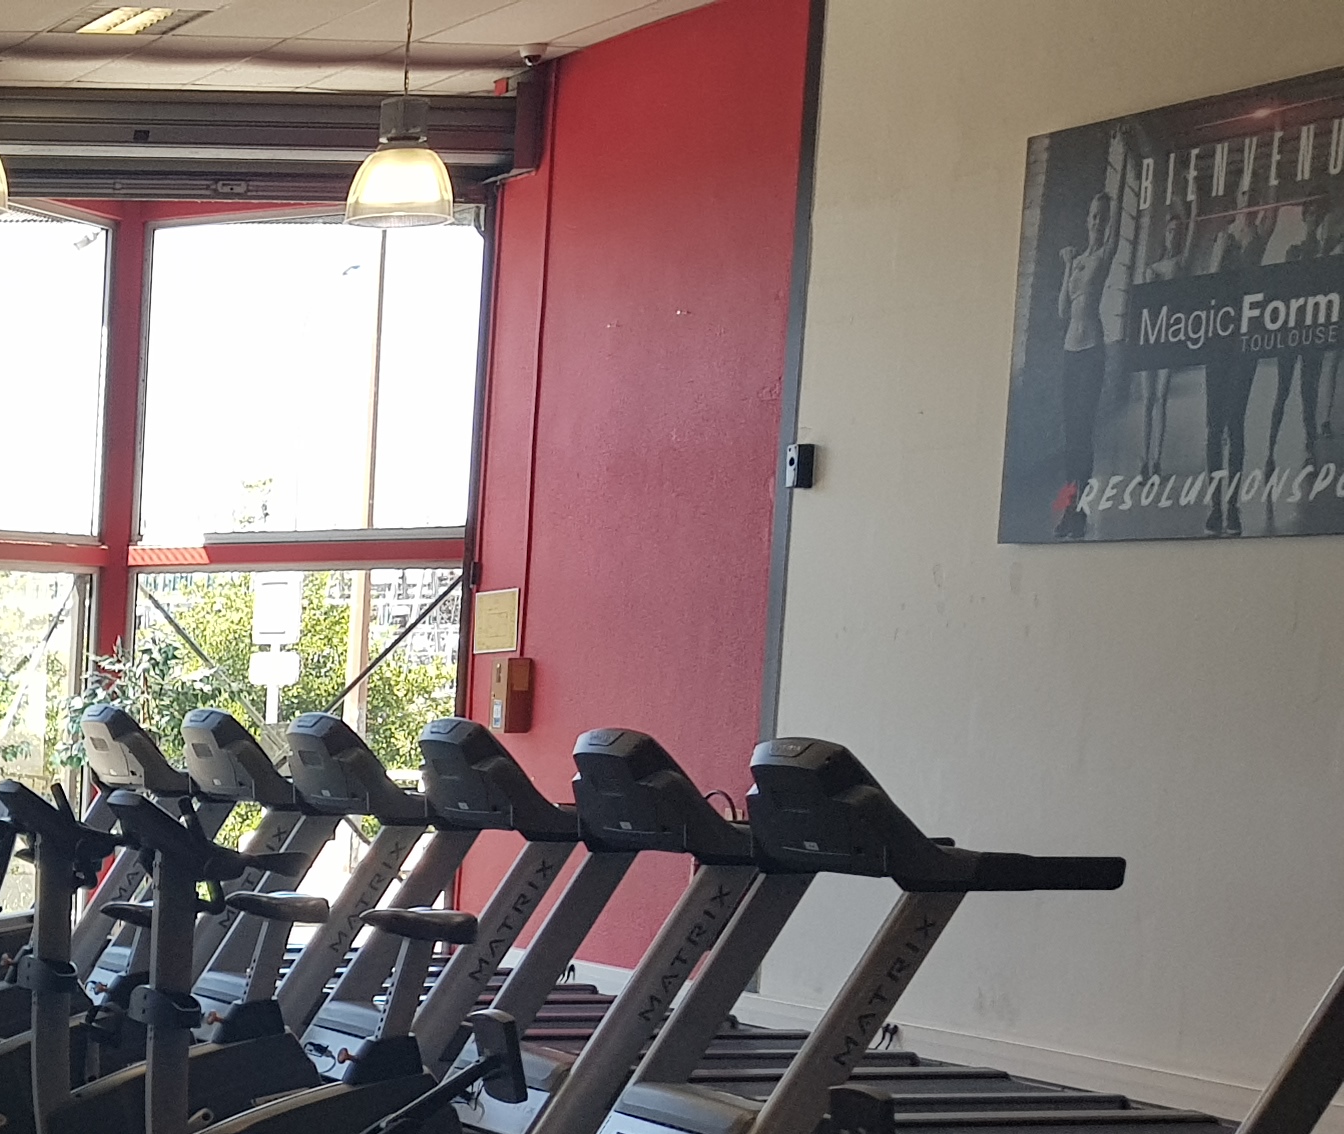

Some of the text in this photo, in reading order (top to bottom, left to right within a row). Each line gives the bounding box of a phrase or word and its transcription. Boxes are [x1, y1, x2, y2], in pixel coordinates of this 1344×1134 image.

[1140, 292, 1340, 350] MagicForm
[1241, 324, 1339, 352] TOULOUSE
[329, 841, 407, 953] MATRIX
[468, 859, 553, 981] MATRIX
[638, 885, 732, 1022] MATRIX
[833, 914, 937, 1067] MATRIX
